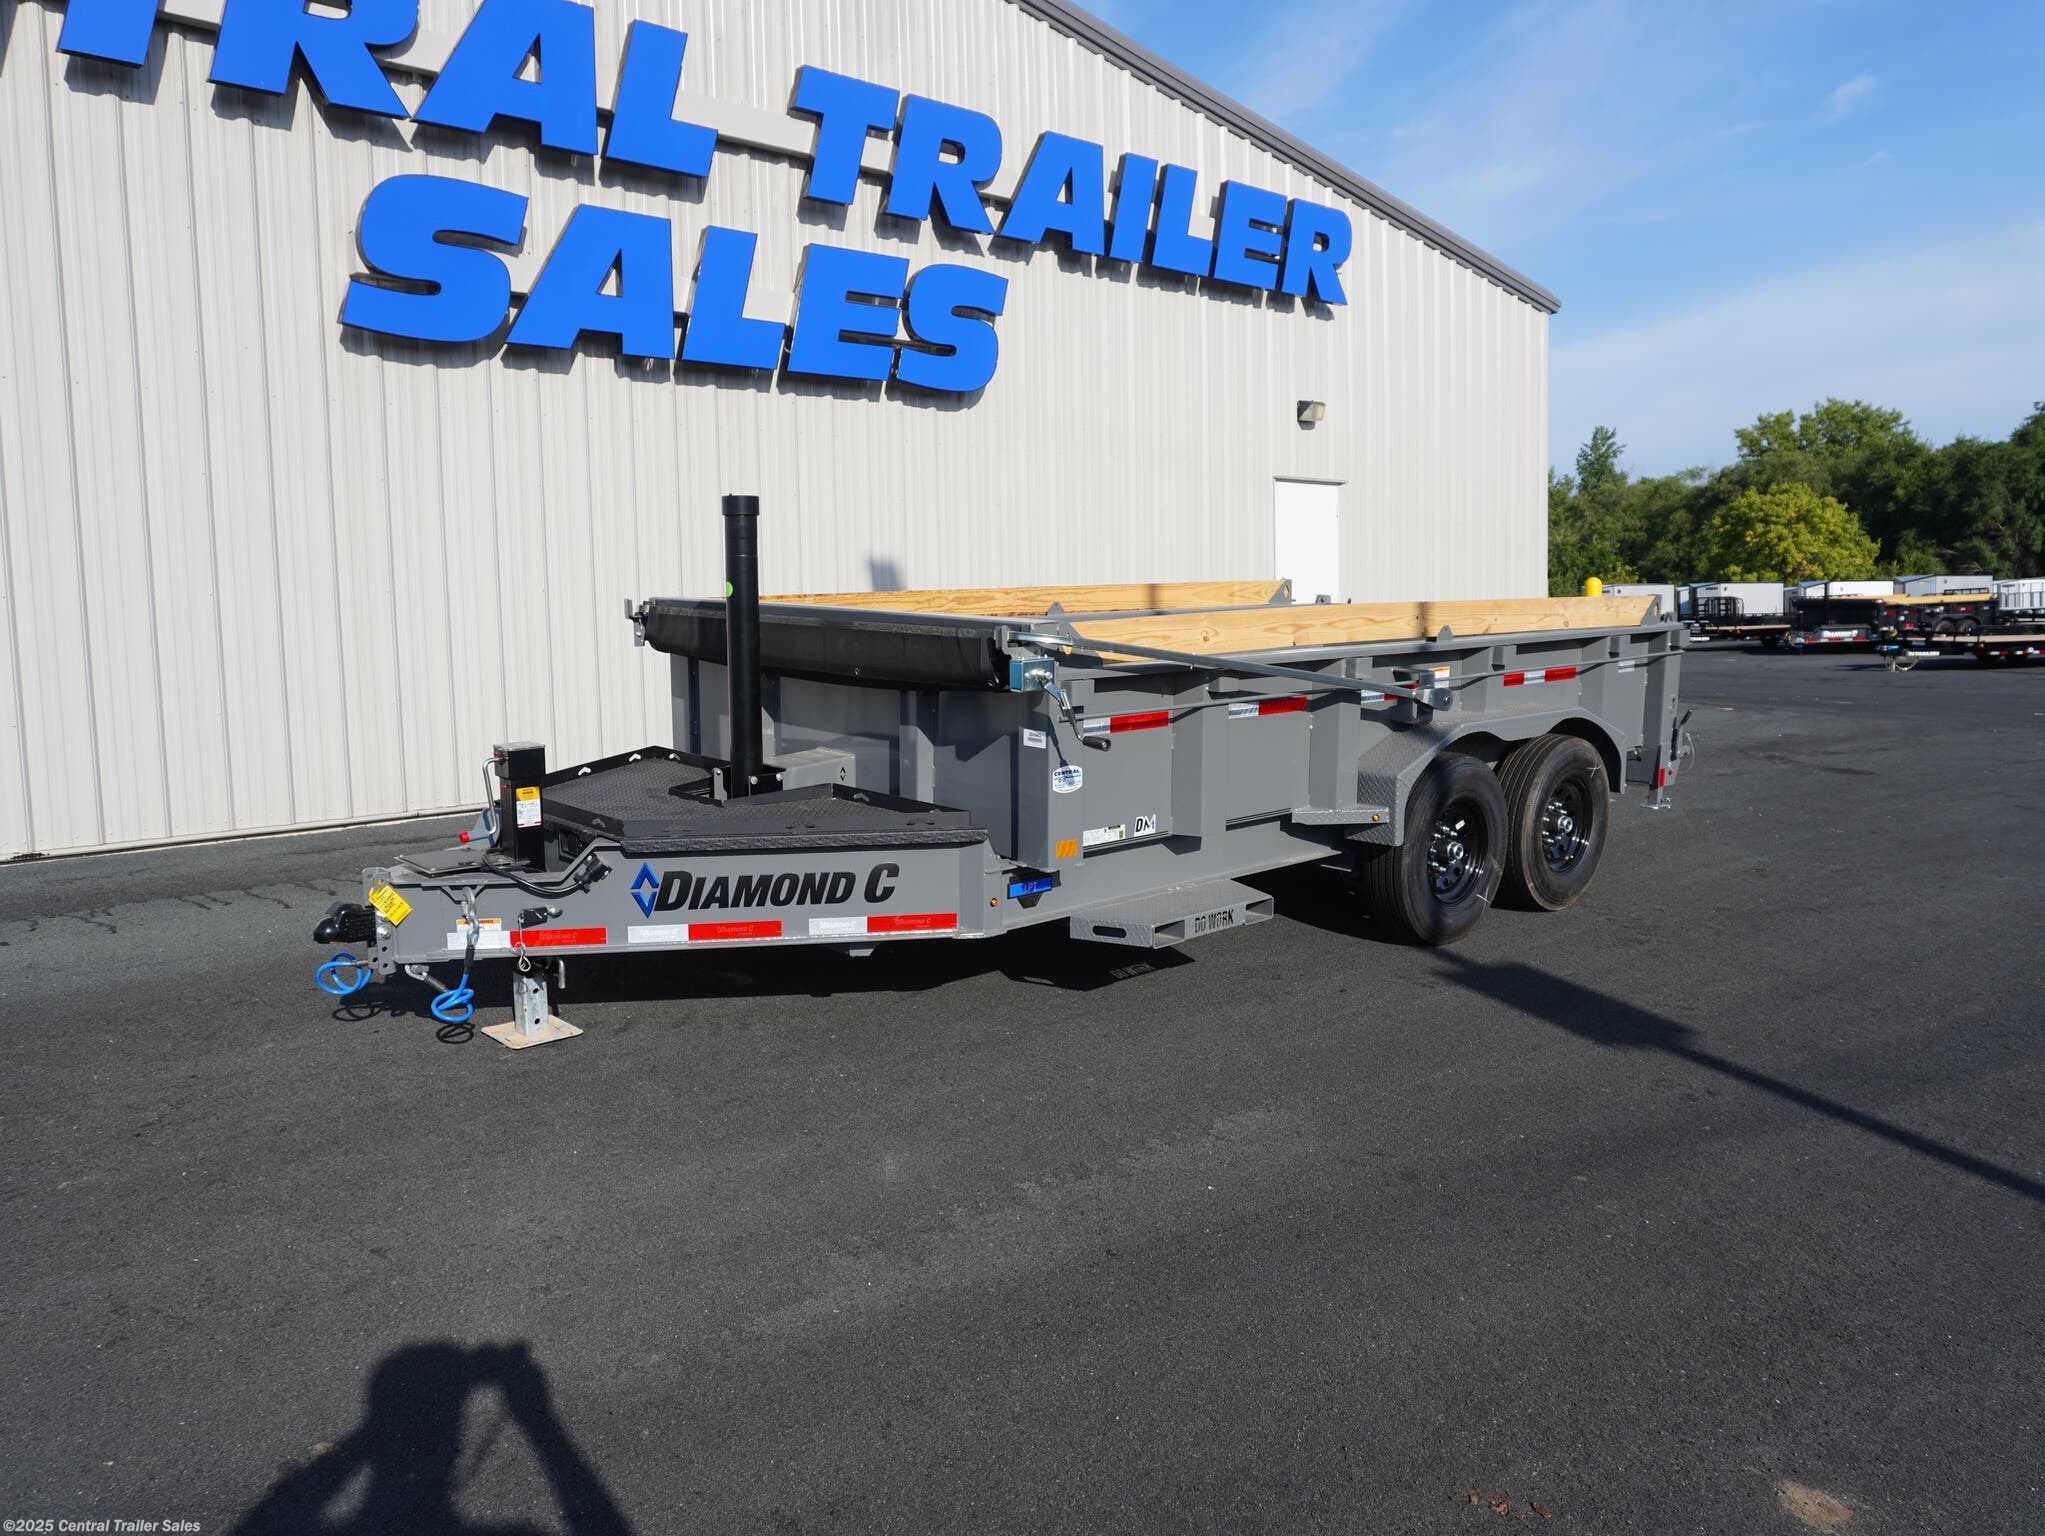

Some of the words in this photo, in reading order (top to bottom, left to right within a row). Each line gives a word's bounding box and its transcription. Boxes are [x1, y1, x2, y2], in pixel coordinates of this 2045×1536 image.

[793, 65, 1353, 306] TRAILER
[340, 174, 1009, 393] SALES
[653, 870, 857, 912] DIAMOND
[863, 862, 900, 904] C
[1194, 915, 1206, 933] DO
[1208, 908, 1234, 930] WORK
